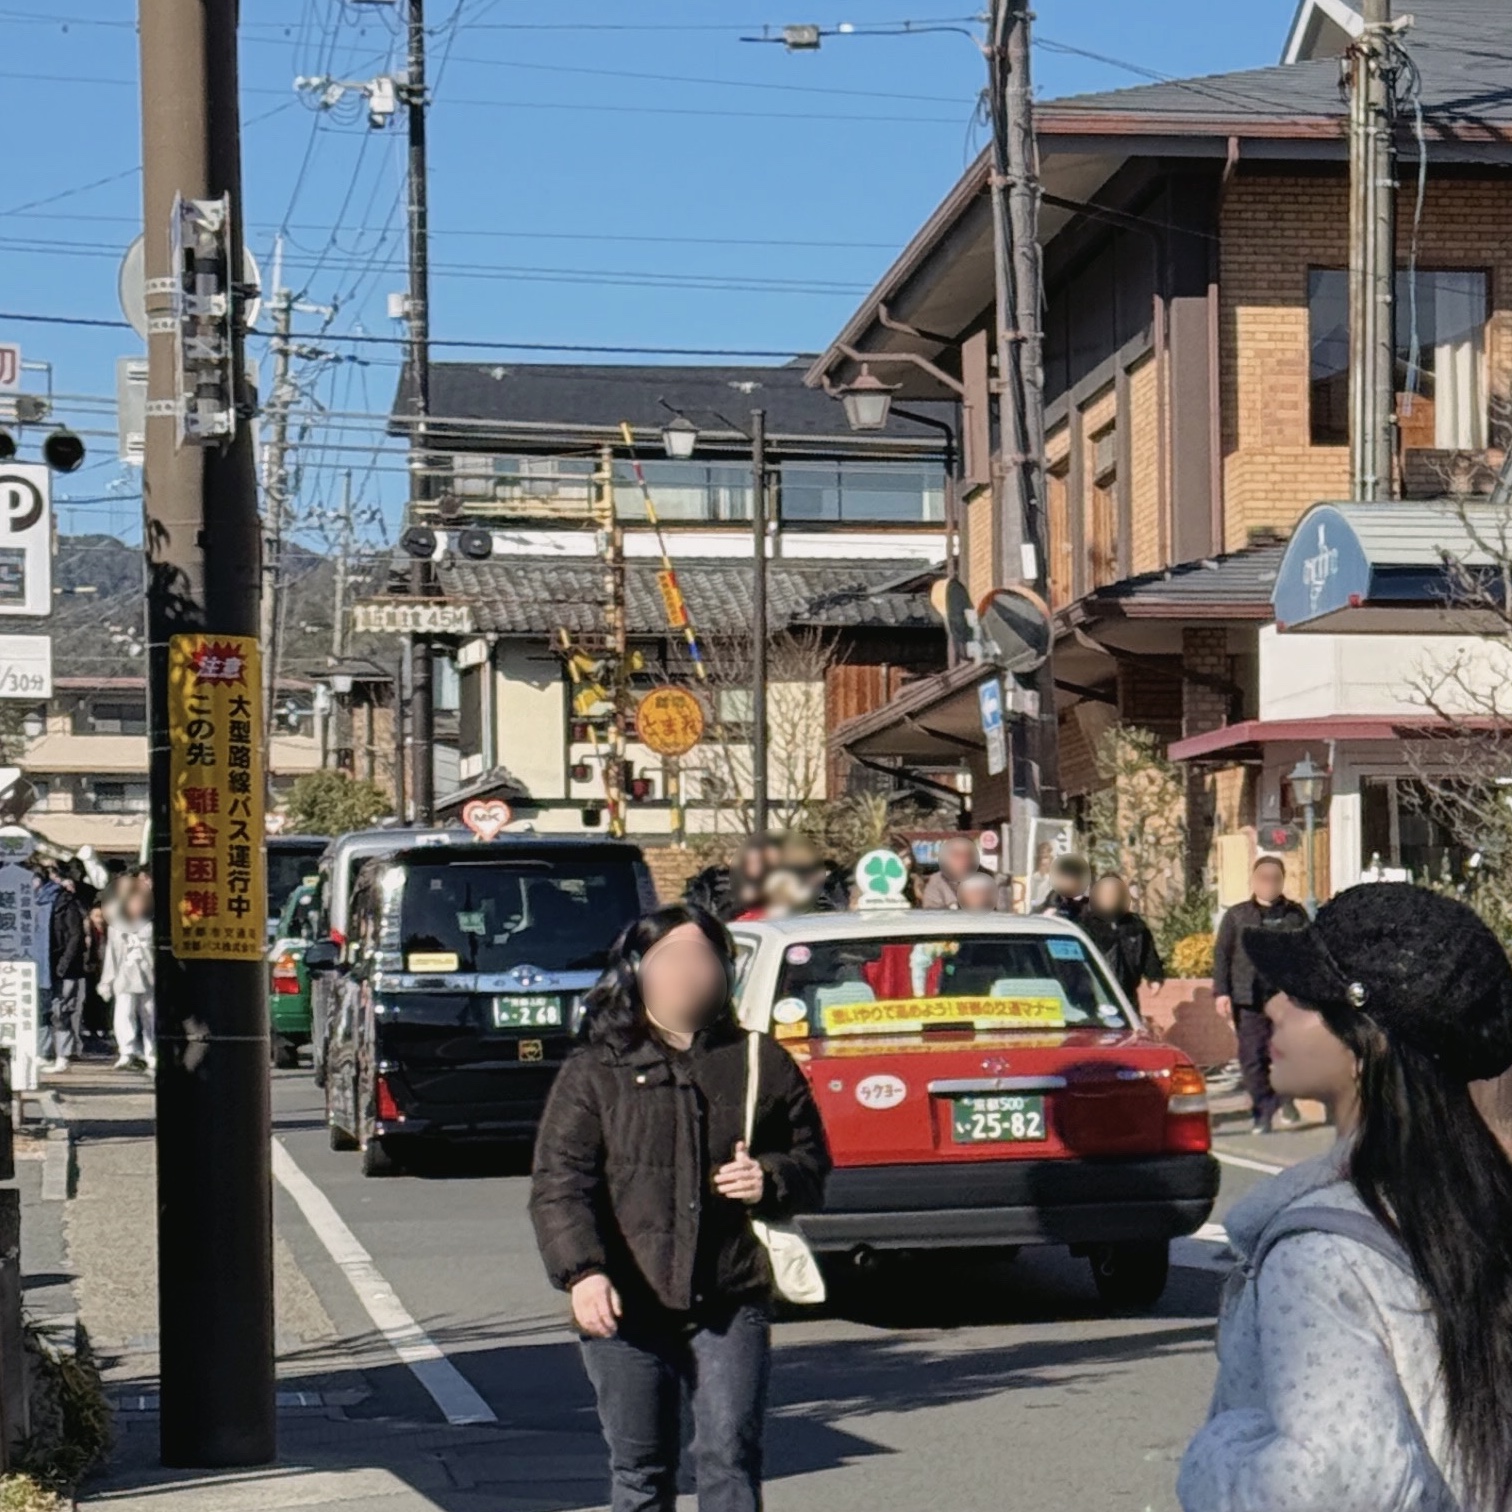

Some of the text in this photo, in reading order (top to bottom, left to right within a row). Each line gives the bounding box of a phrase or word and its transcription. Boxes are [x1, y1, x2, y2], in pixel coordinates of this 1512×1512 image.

[200, 656, 242, 678] 注意
[186, 694, 216, 766] この先
[227, 695, 252, 920] 大型路線バス運行中
